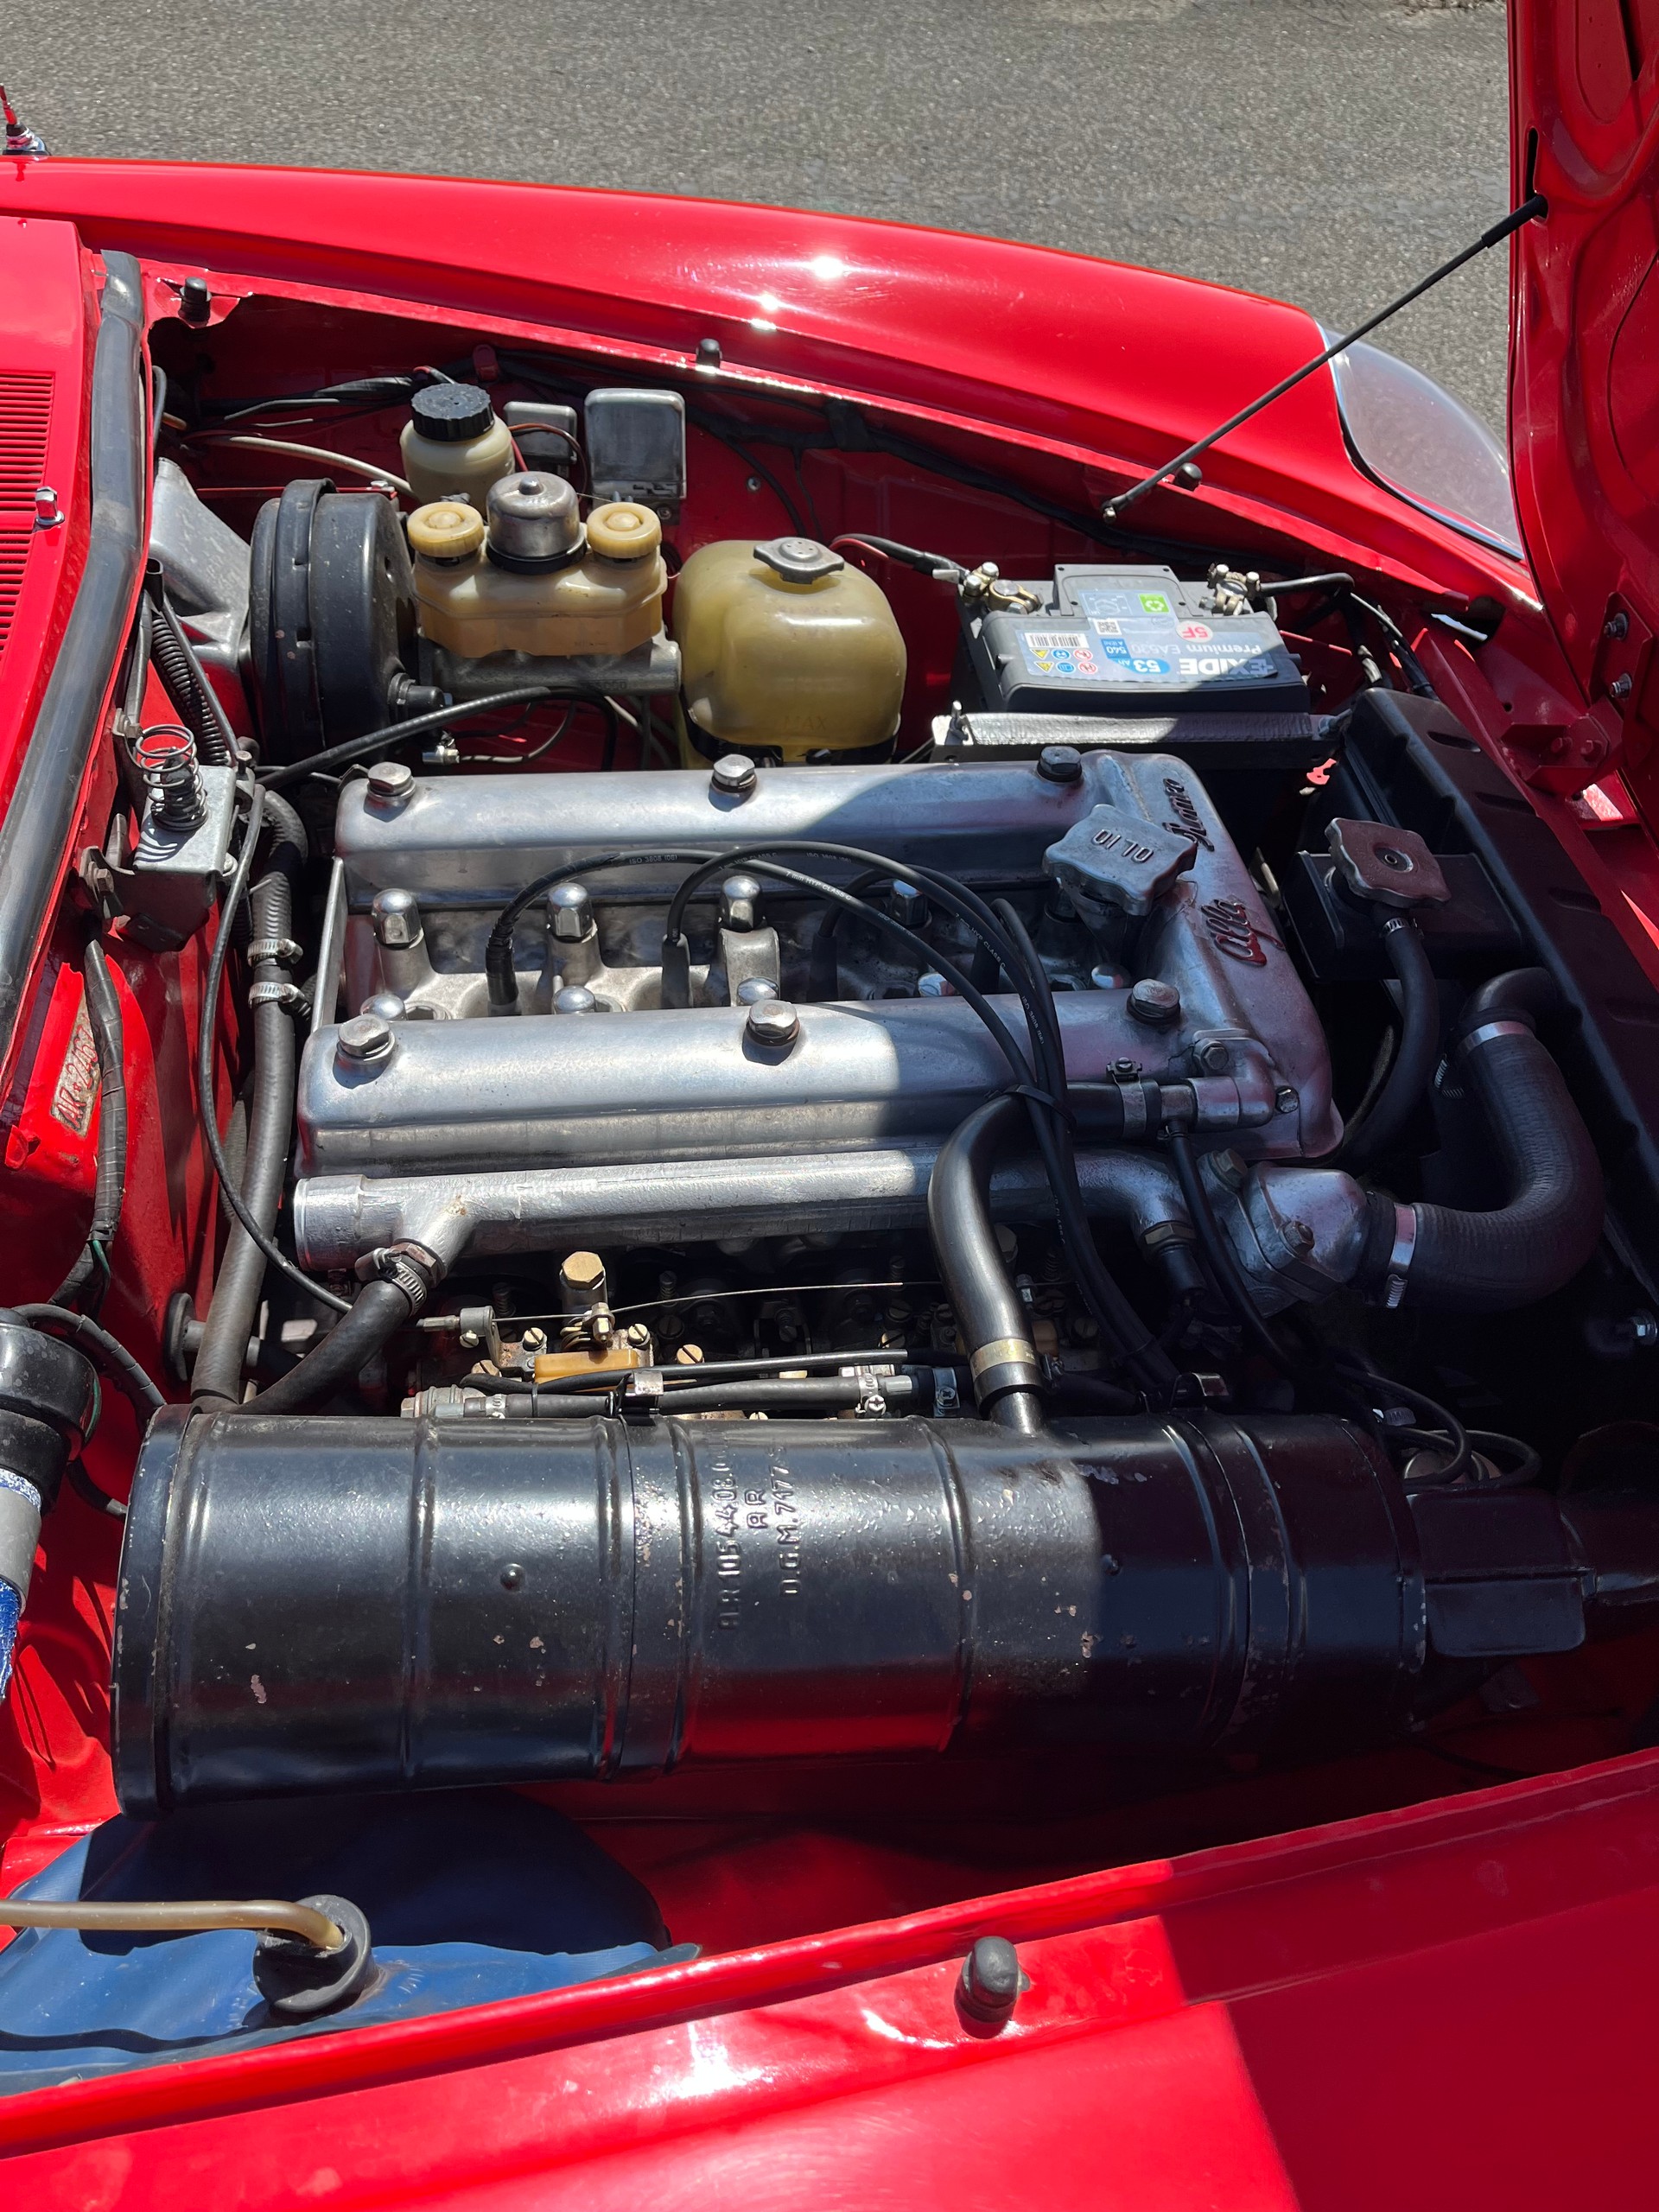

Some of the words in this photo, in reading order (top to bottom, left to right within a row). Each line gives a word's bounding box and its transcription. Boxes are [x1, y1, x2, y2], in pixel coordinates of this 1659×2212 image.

[1182, 627, 1208, 639] 5F
[1131, 644, 1180, 654] EA530
[1188, 645, 1262, 654] Premium
[1134, 659, 1161, 672] 53
[1179, 658, 1274, 675] EXIDE
[1091, 829, 1154, 863] OLIO
[645, 855, 662, 863] 3808
[791, 873, 804, 882] mm
[805, 875, 822, 887] HYP
[822, 883, 845, 897] CLASS
[983, 940, 1001, 963] CLASS
[1021, 995, 1030, 1010] ISO
[56, 1088, 86, 1129] AR
[744, 1490, 768, 1529] AR
